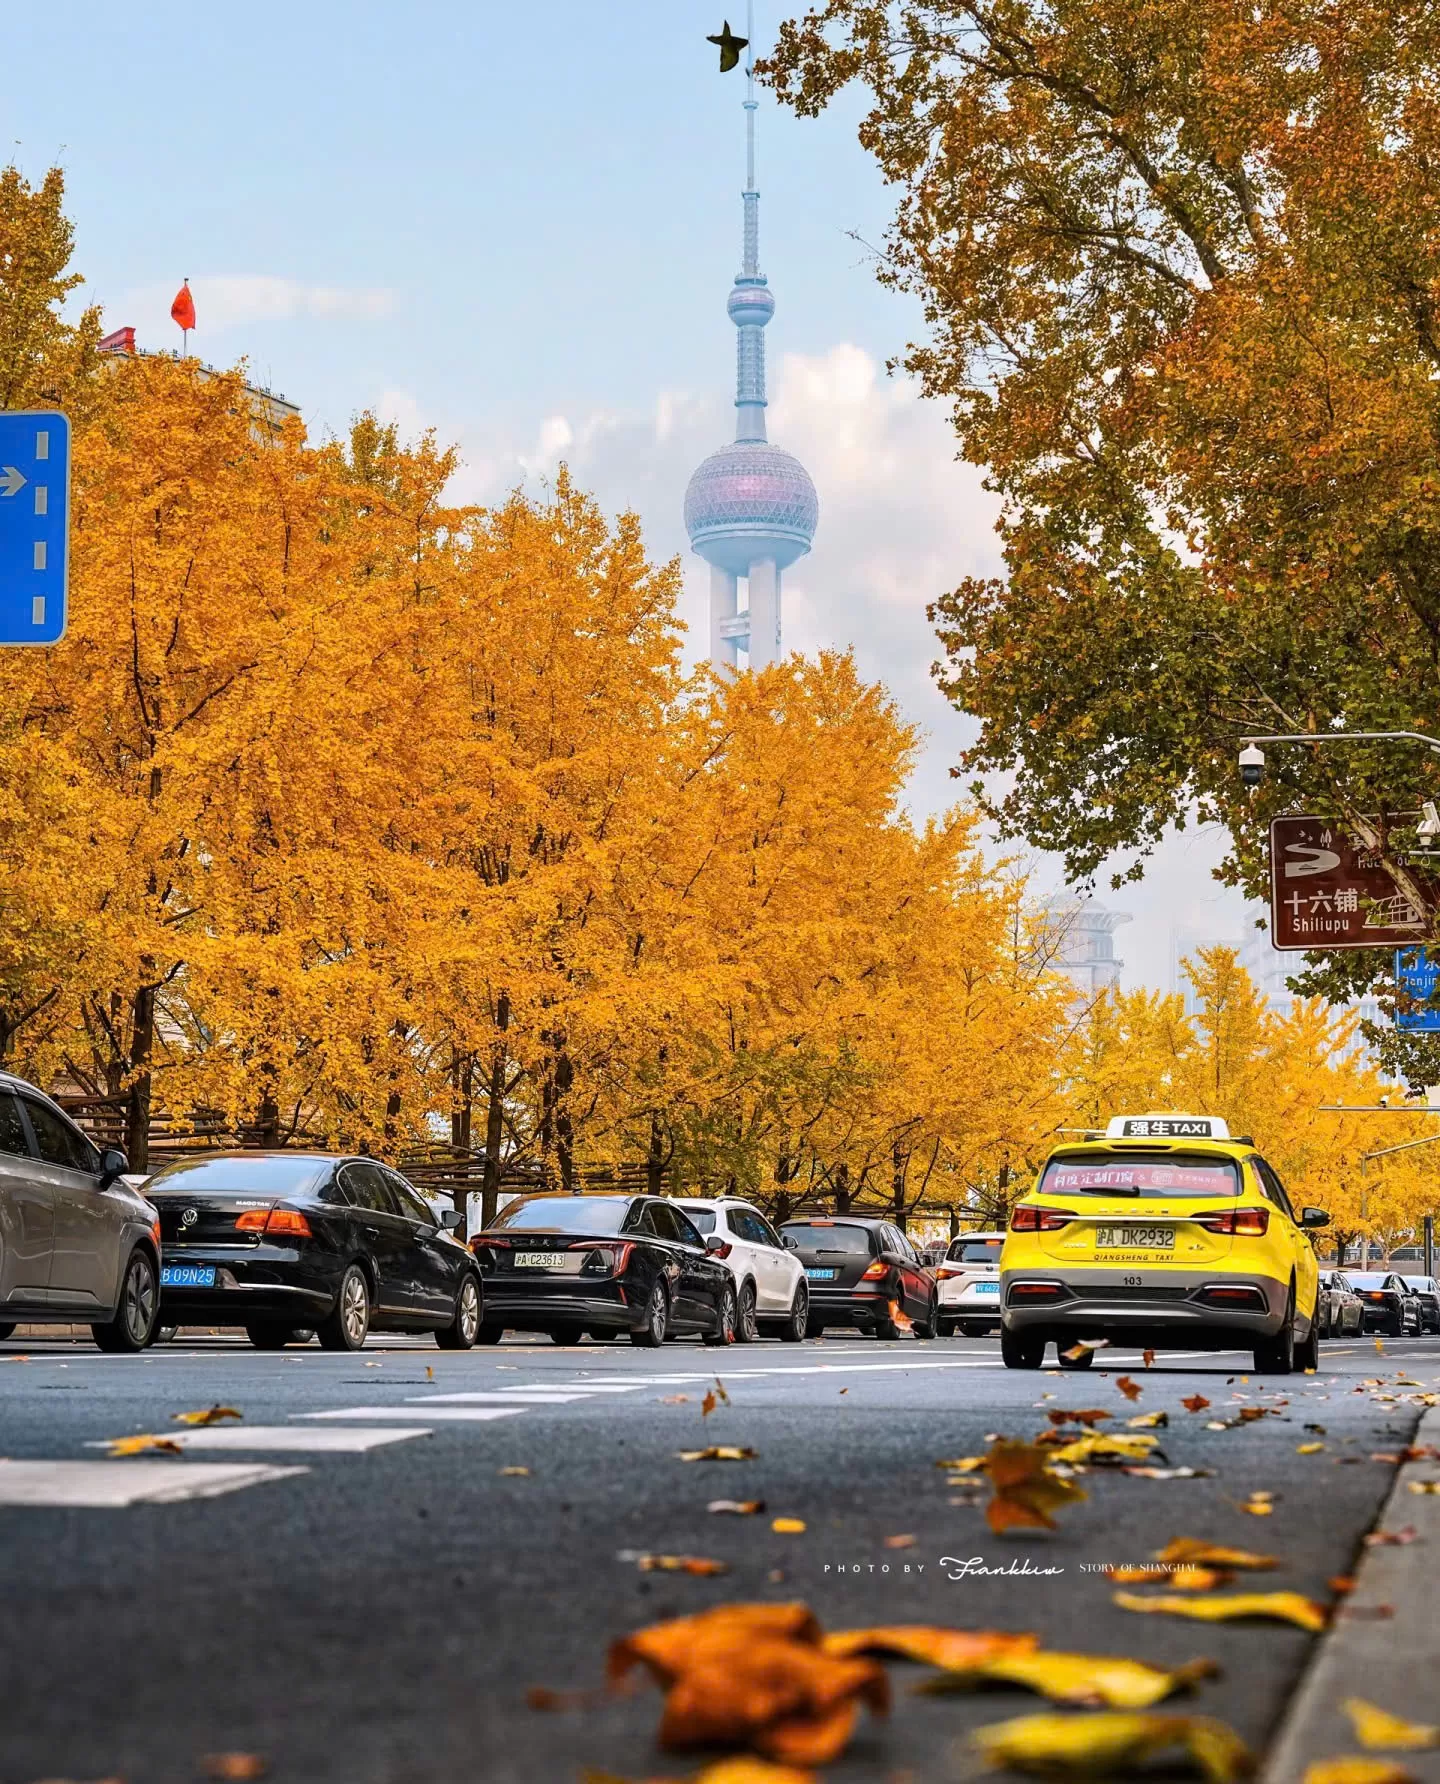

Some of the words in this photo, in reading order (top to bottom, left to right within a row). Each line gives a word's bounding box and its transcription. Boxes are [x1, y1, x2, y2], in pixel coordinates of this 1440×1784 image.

[1284, 888, 1358, 915] 十六铺
[1293, 917, 1350, 934] Shiliupu
[1121, 1229, 1174, 1246] DK2932
[530, 1254, 563, 1266] C23613
[173, 1268, 214, 1284] 09N25
[1123, 1276, 1143, 1286] 103
